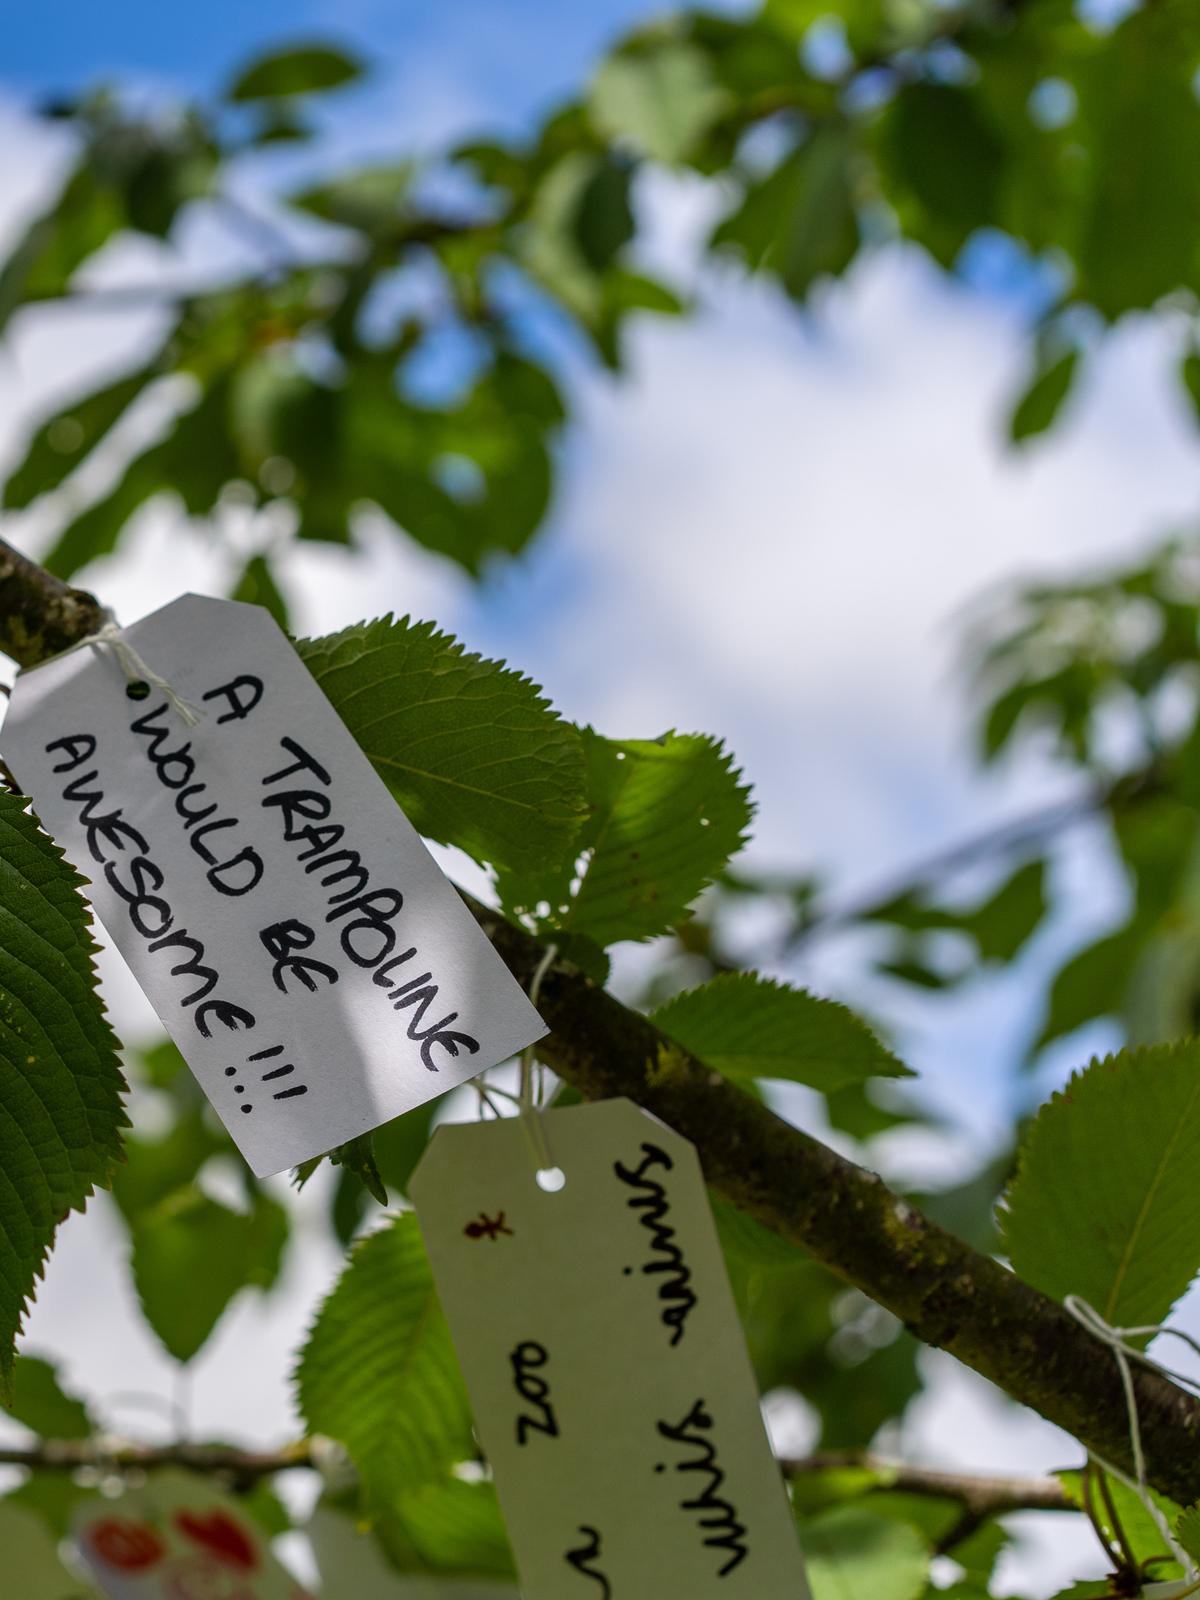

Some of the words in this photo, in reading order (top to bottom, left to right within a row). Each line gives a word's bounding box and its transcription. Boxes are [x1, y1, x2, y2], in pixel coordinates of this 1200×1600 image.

[45, 733, 308, 1114] AWESOME!!!
[130, 702, 265, 897] WOULD
[259, 918, 339, 995] BE
[202, 674, 265, 725] A
[261, 736, 481, 1073] TRAMPOLINE
